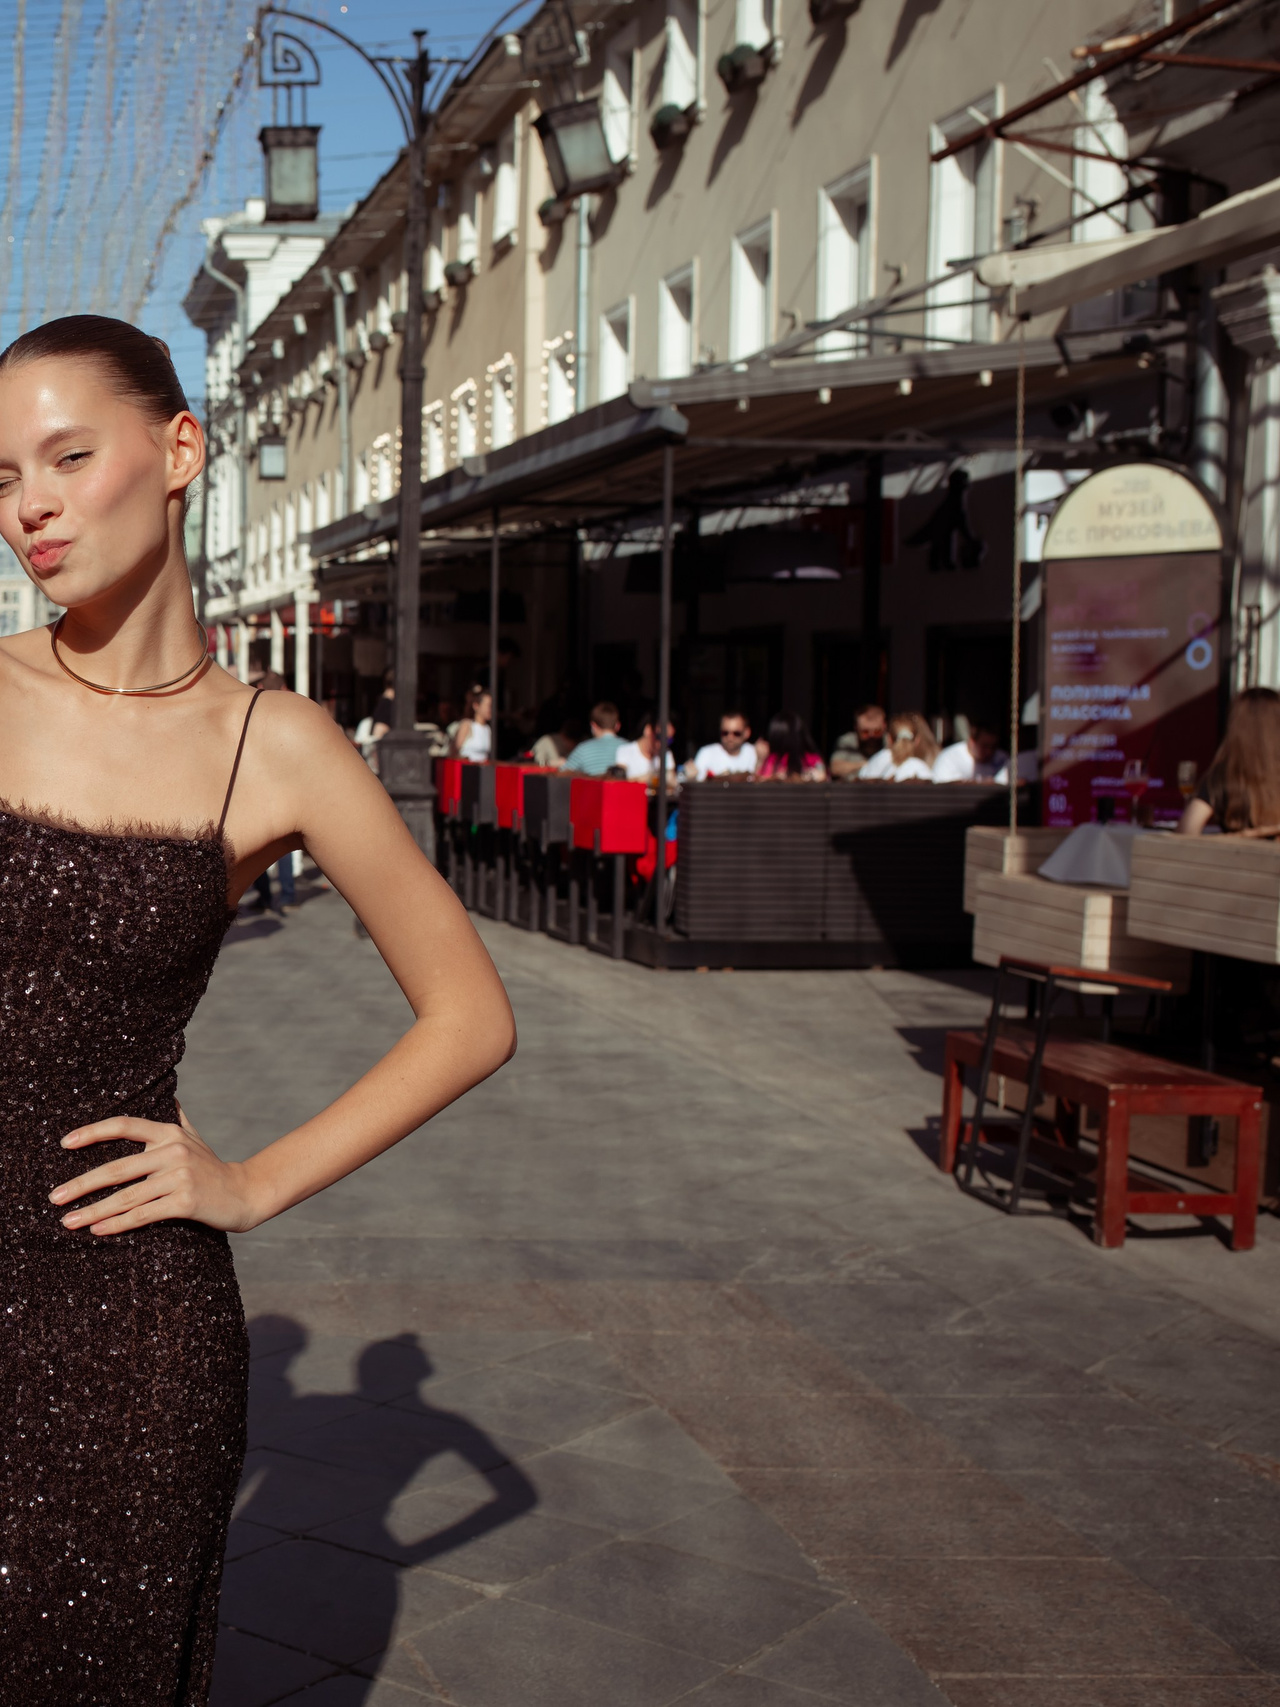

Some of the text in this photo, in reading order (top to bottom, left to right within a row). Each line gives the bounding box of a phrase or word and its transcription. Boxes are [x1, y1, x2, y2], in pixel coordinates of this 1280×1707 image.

[1098, 495, 1165, 517] МУЗЕЙ
[1086, 519, 1217, 542] ПРОКОФЬЕВА
[1050, 684, 1151, 701] ПОПУЛЯРНАЯ
[1050, 704, 1132, 720] КЛАССИКА
